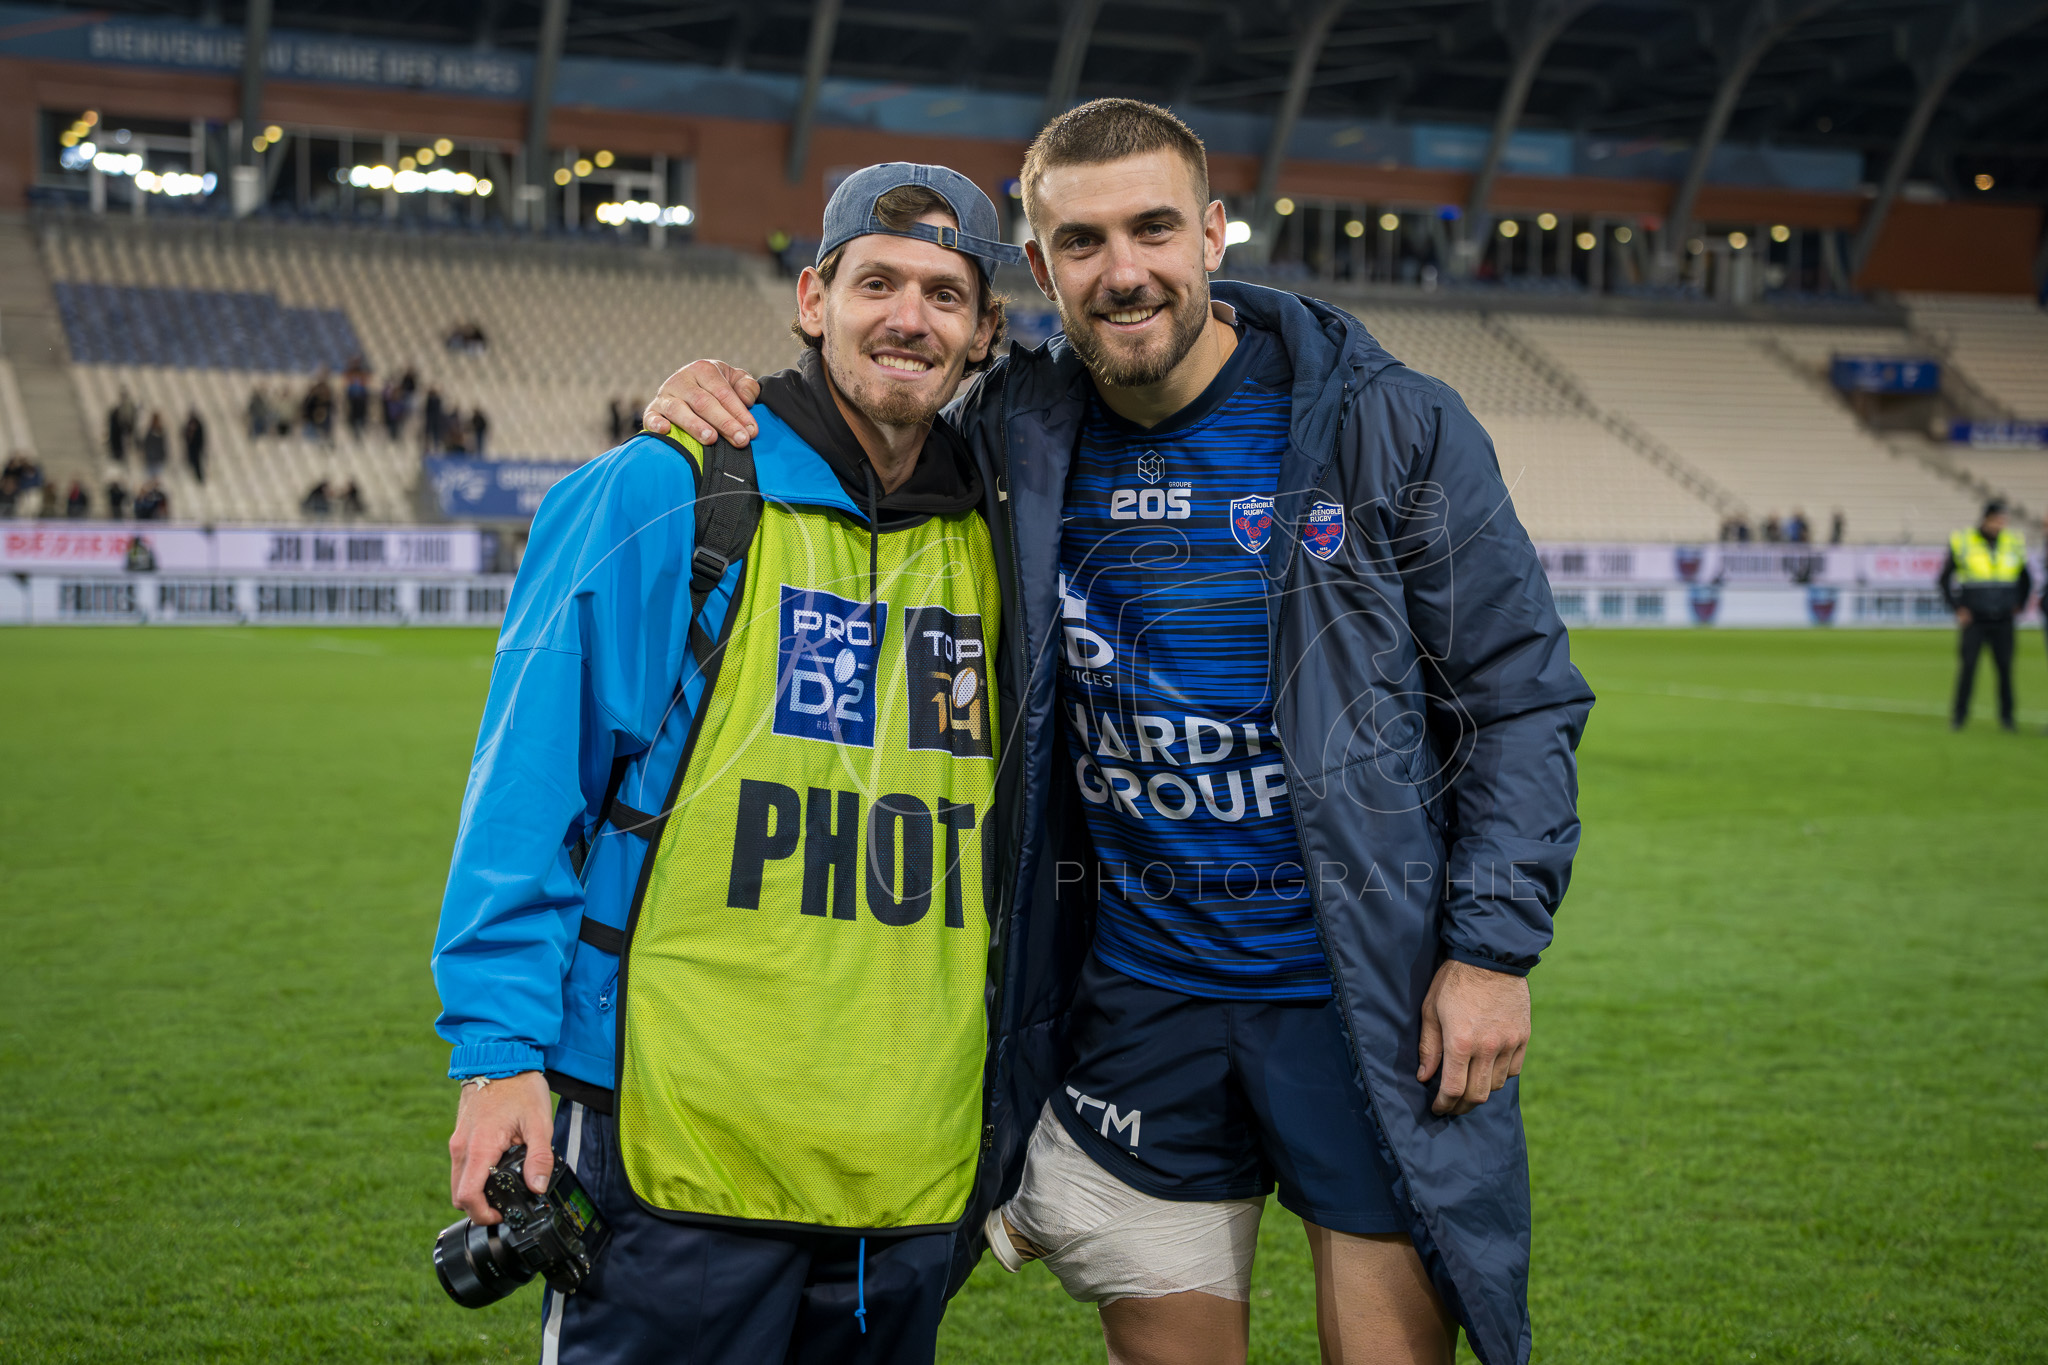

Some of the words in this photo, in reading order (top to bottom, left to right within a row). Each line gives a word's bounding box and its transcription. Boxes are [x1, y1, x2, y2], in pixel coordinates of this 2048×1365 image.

[1242, 501, 1274, 510] GRENOBLE
[1310, 515, 1332, 523] RUGBY
[793, 609, 873, 647] PRO
[922, 630, 983, 664] TOP
[789, 669, 865, 722] D2
[816, 720, 843, 732] RUGBY
[931, 691, 982, 741] 14
[1075, 753, 1289, 822] GROUP
